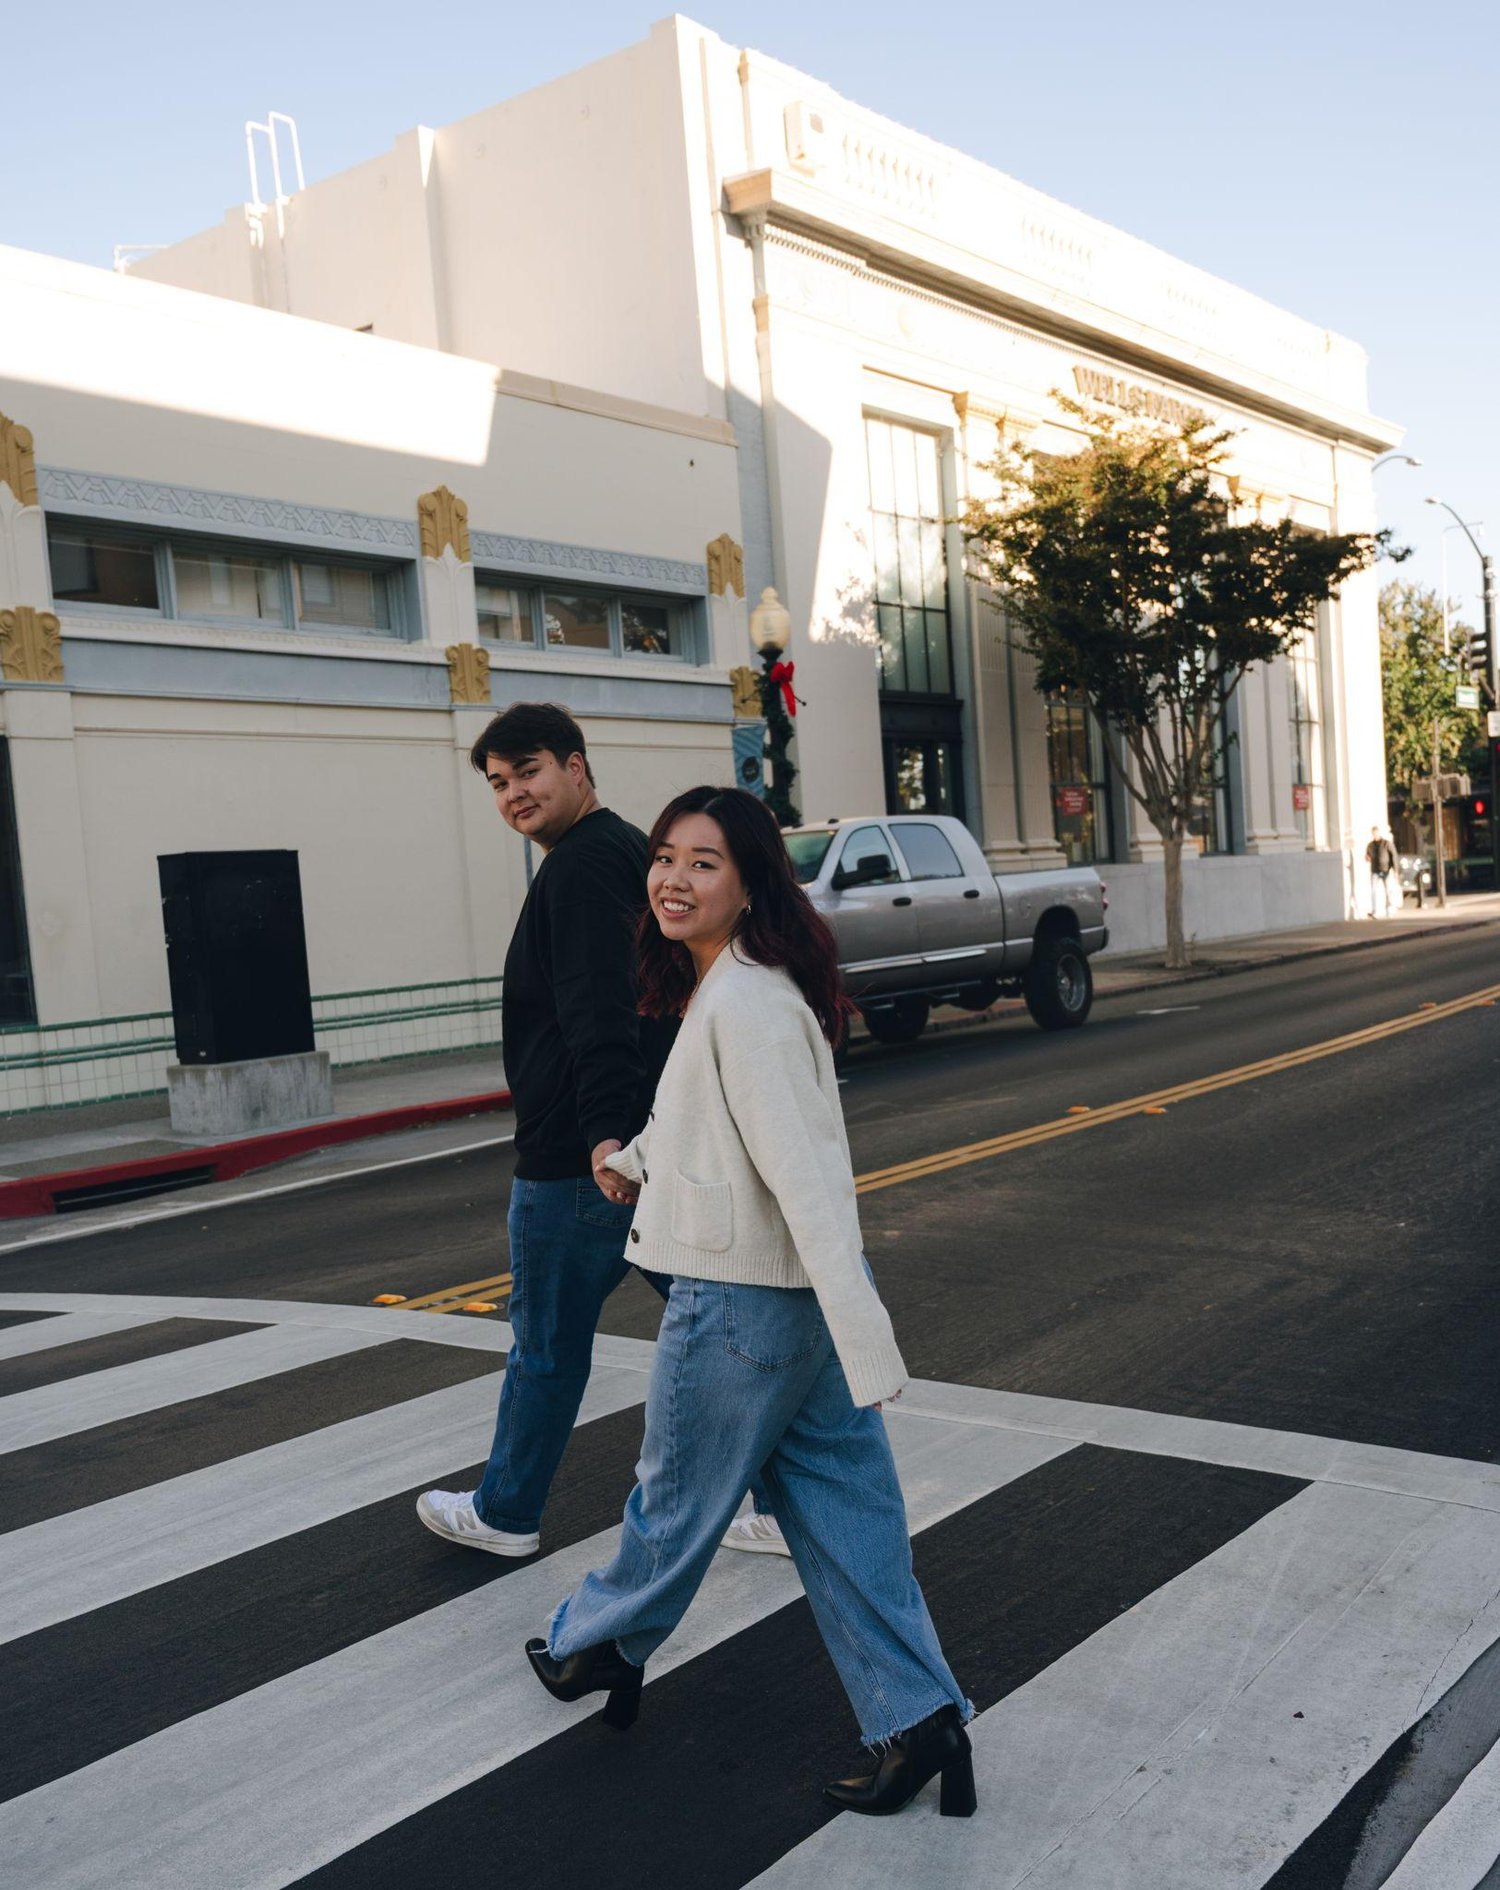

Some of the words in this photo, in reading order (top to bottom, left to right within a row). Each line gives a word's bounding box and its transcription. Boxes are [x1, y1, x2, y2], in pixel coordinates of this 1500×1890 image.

[1072, 365, 1144, 413] WELLS
[455, 1510, 478, 1531] N
[749, 1518, 772, 1540] N
